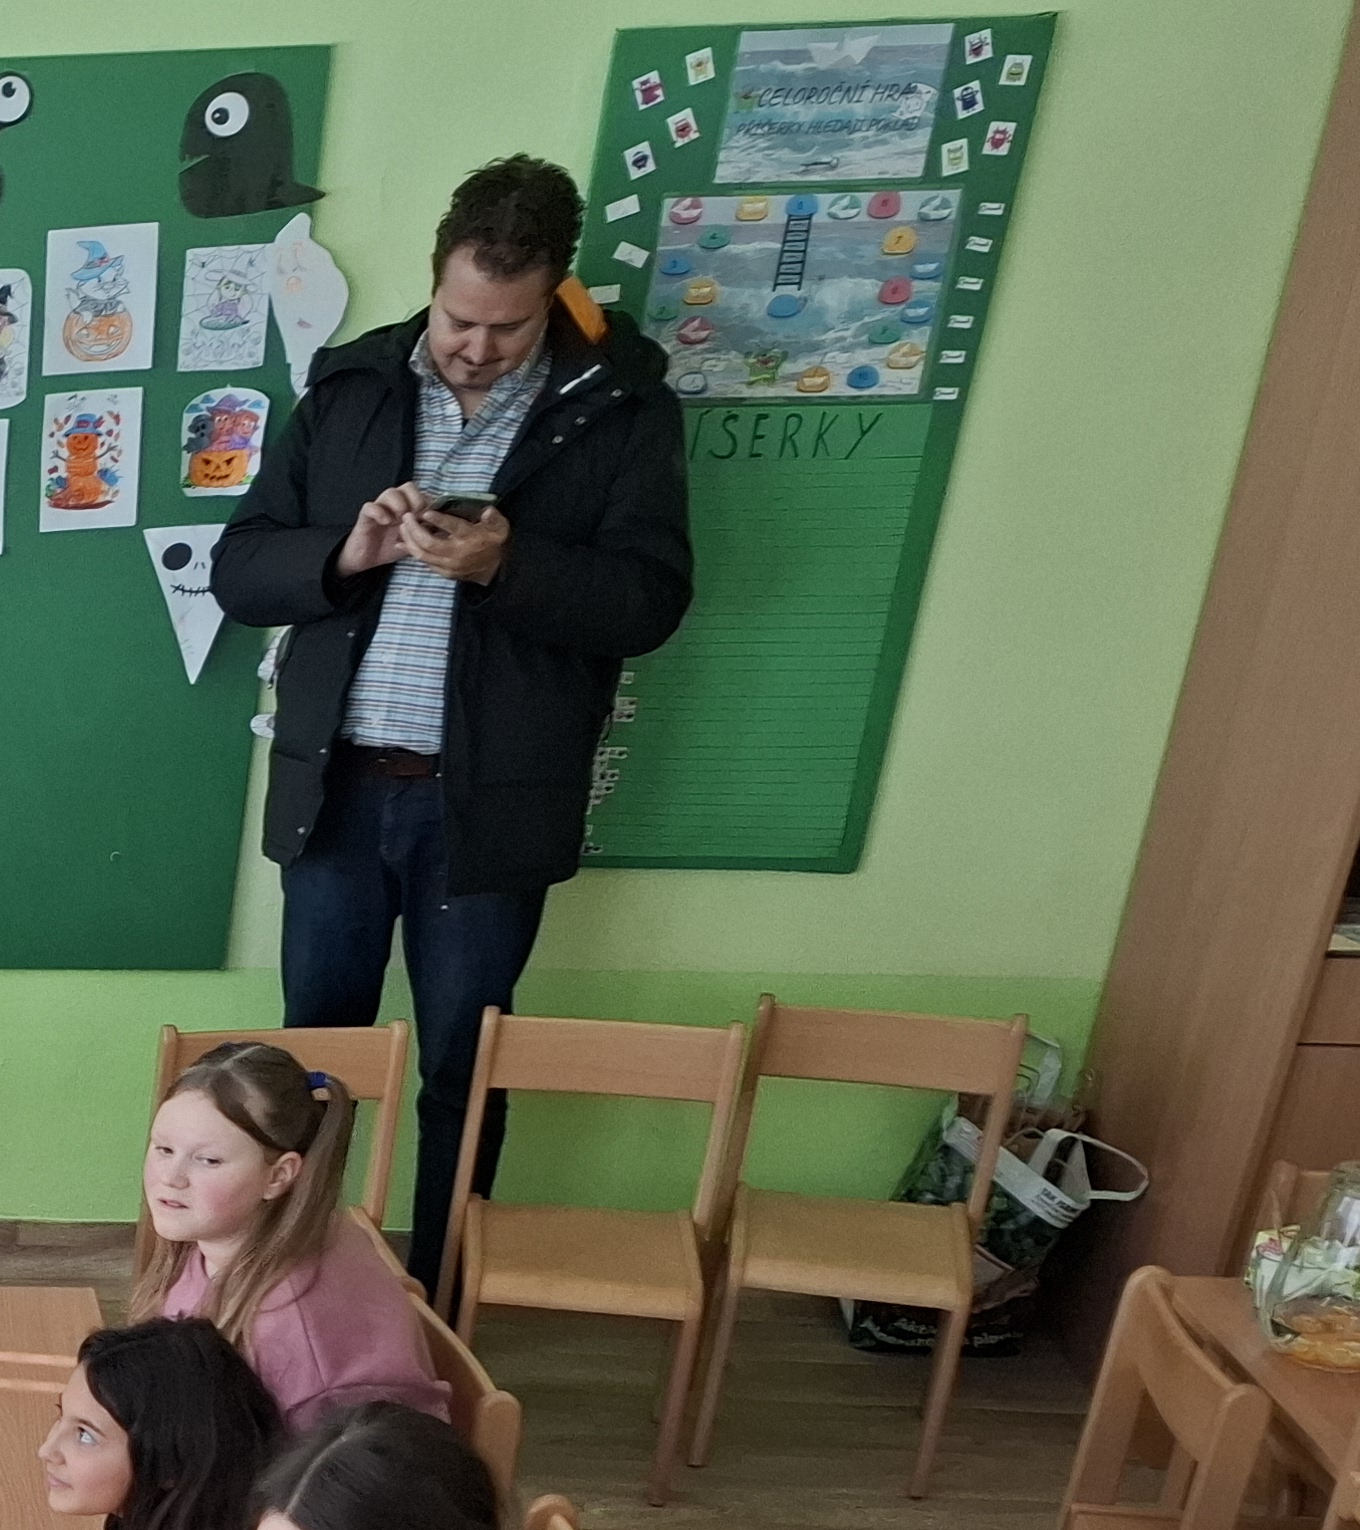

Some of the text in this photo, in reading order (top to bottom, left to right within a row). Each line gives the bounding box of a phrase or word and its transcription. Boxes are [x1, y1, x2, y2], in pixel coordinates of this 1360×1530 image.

[757, 80, 918, 107] CELOROČNÍ HRA
[689, 409, 884, 461] ÍŠERKY
